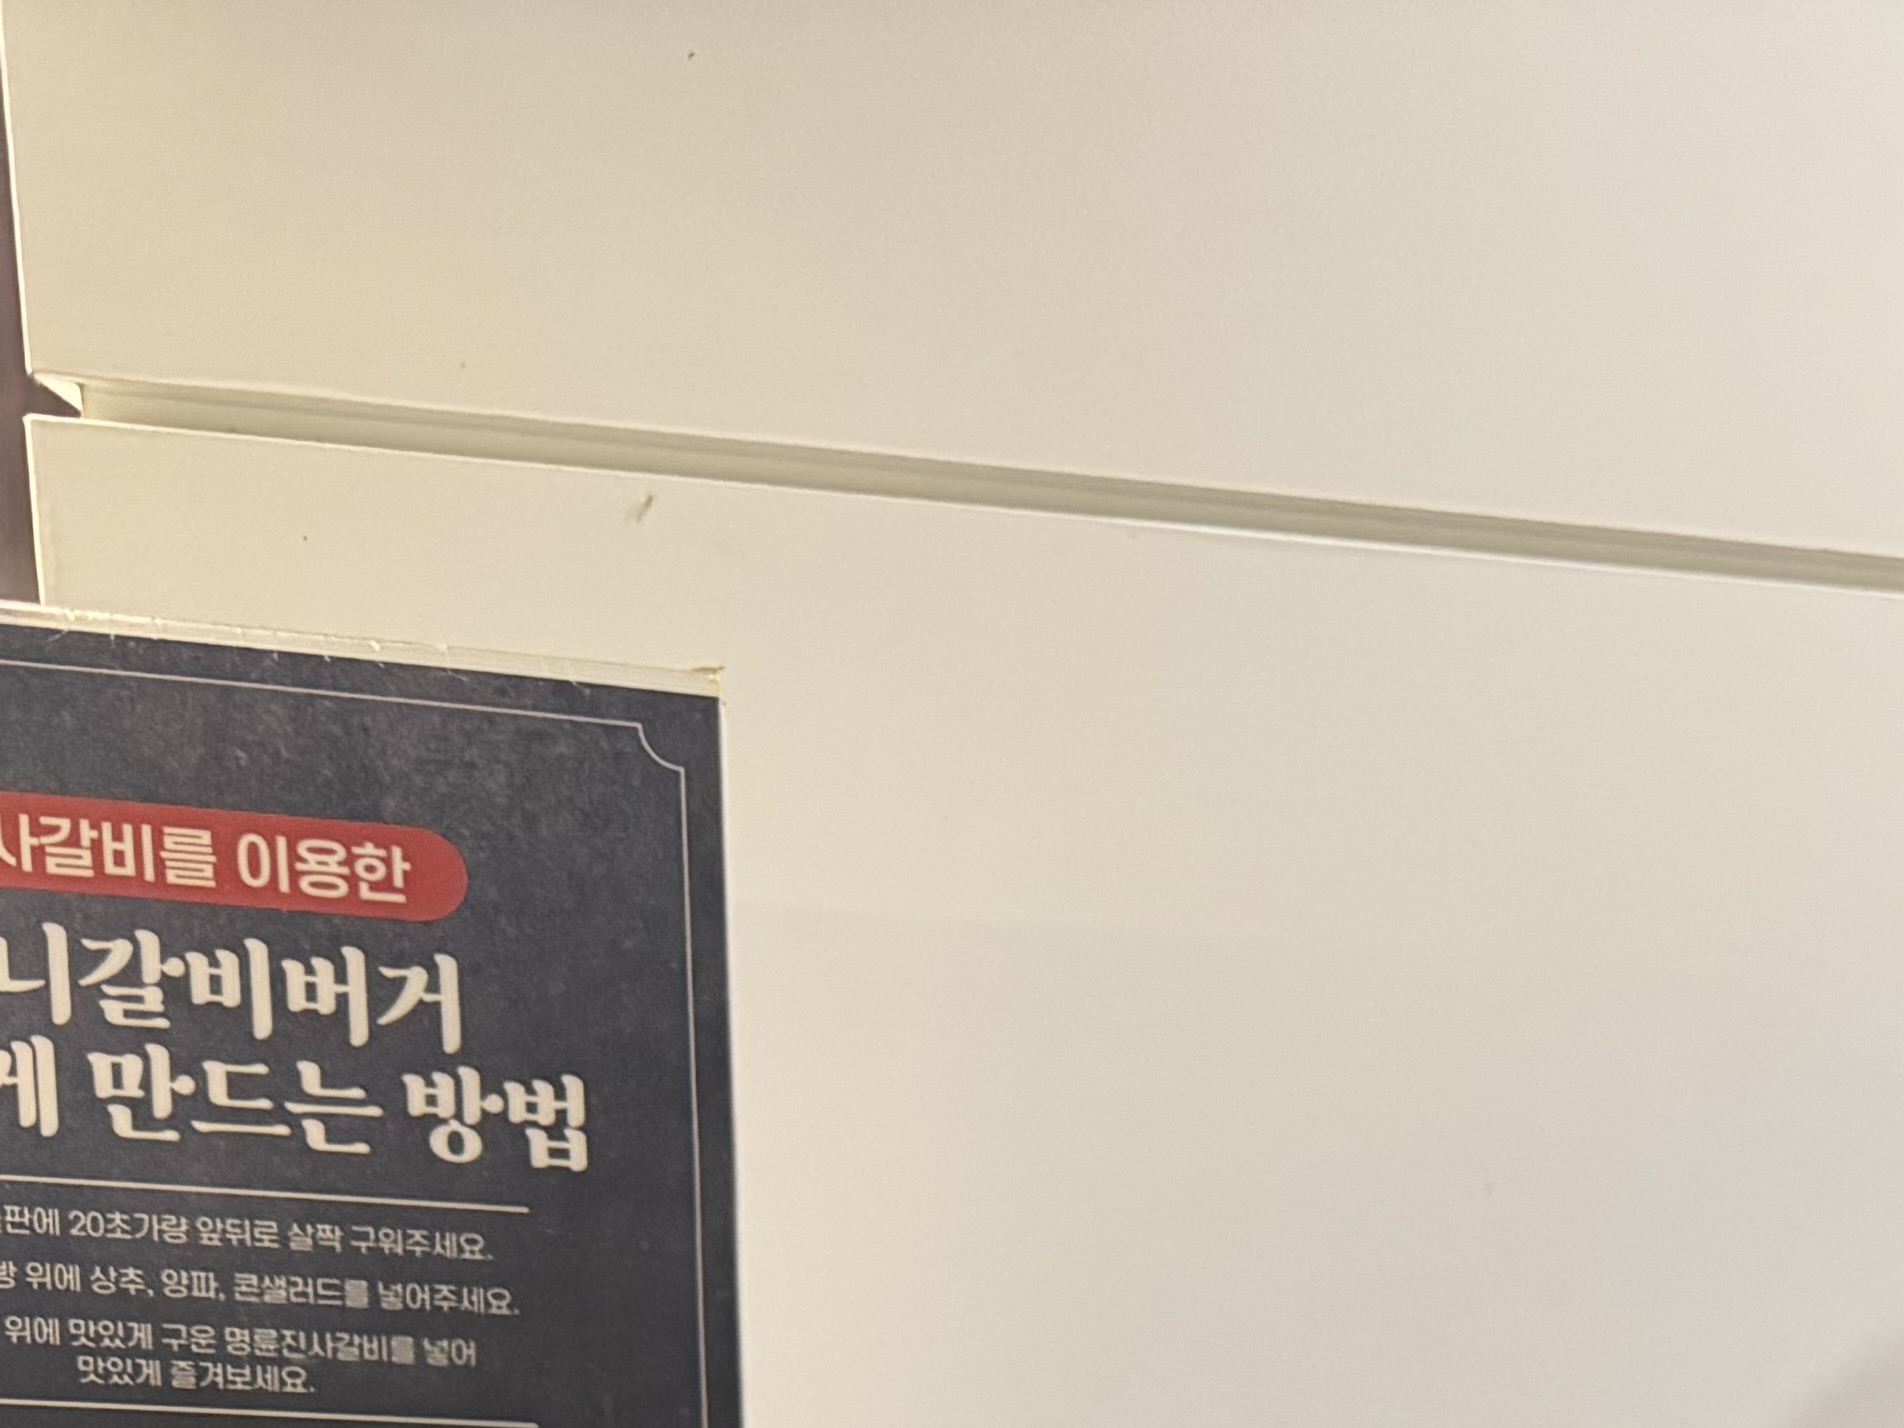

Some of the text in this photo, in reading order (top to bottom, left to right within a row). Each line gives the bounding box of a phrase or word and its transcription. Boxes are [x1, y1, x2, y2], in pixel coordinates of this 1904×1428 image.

[237, 834, 411, 904] 이용한
[87, 1043, 384, 1154] 만드는
[403, 1066, 590, 1172] 방법
[0, 1205, 494, 1261] 판에 20초가량 앞뒤로 살짝 구워주세요.
[25, 1262, 82, 1293] 위에
[90, 1266, 154, 1297] 상추,
[161, 1269, 226, 1301] 양파,
[378, 1281, 520, 1316] 넣어주세요.
[4, 1316, 61, 1346] 위에
[68, 1318, 153, 1351] 맛있게
[161, 1323, 217, 1355] 구운
[423, 1337, 478, 1368] 넣어
[77, 1355, 318, 1394] 맛있게 즐겨보세요.
